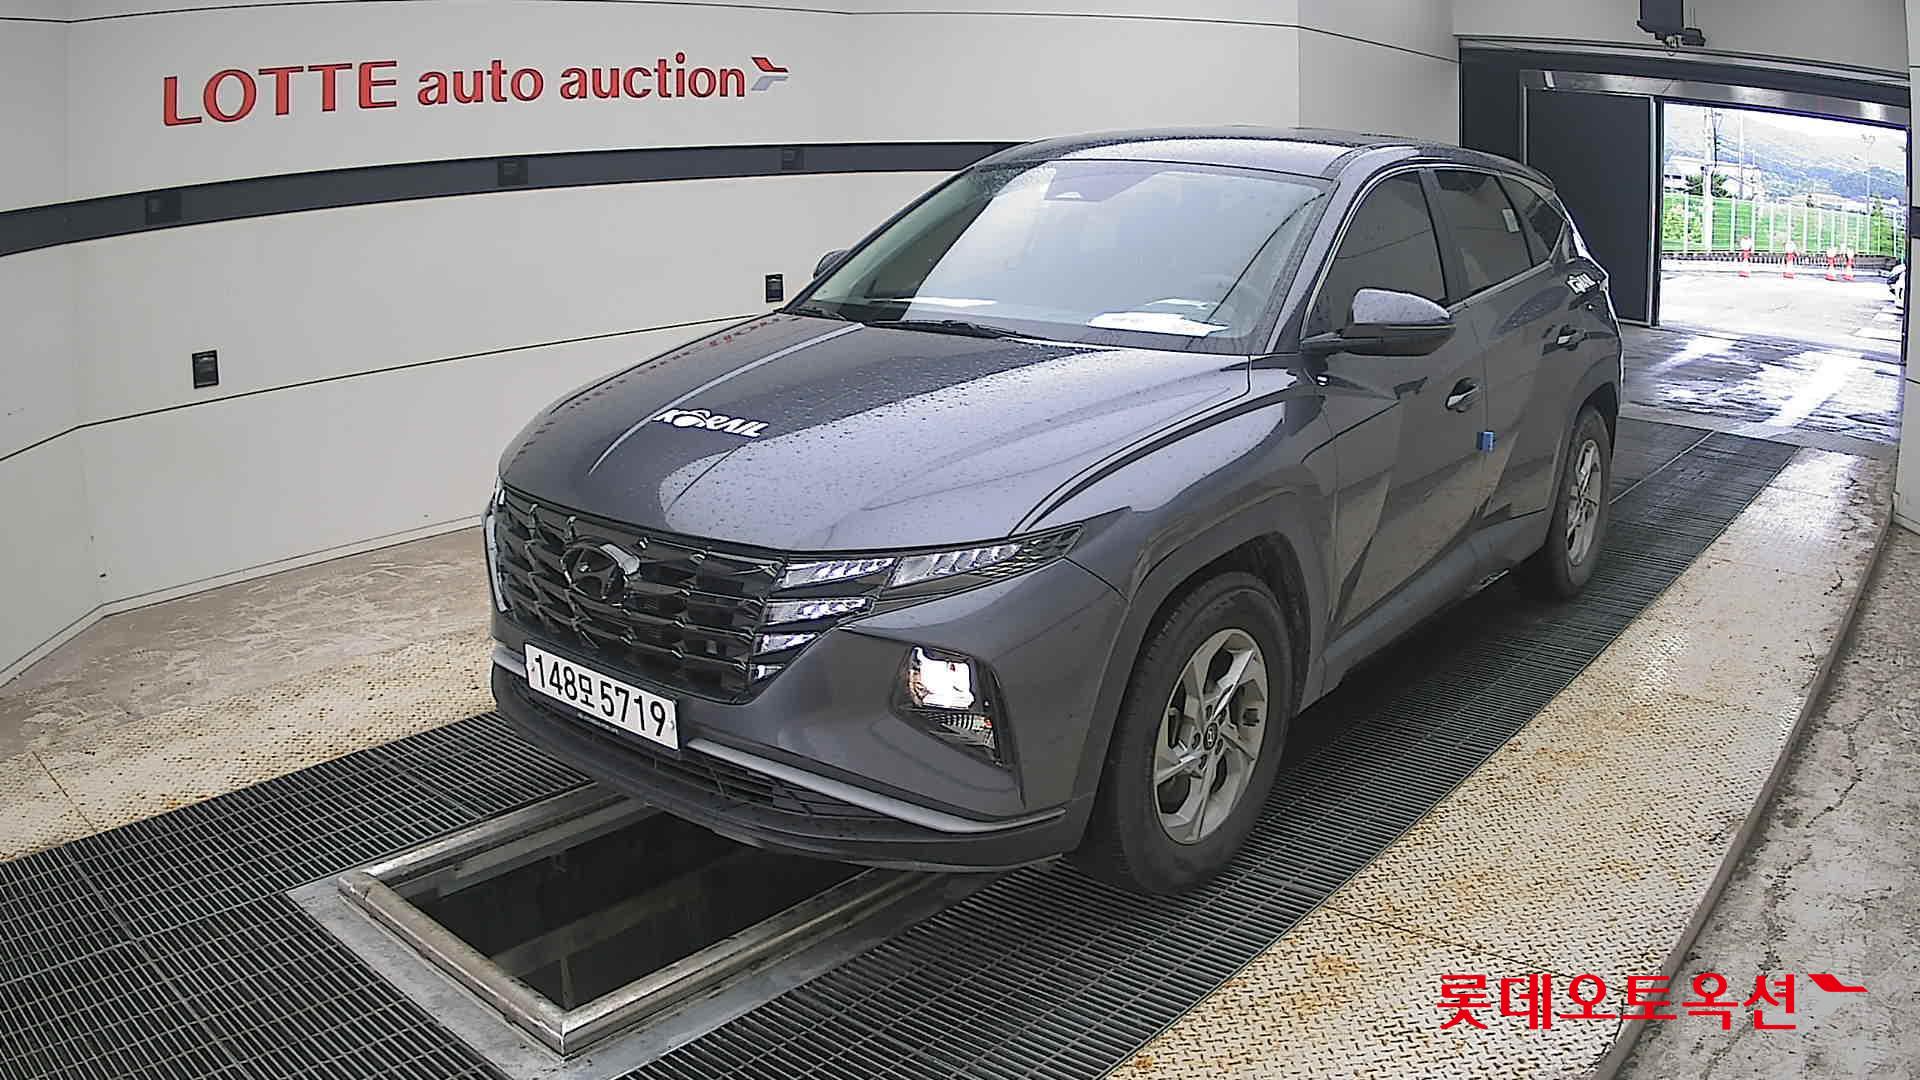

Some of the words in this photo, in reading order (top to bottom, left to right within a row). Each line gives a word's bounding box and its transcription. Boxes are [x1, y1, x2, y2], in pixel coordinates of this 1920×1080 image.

[164, 61, 397, 126] LOTTE
[417, 60, 544, 105] auto
[560, 53, 746, 99] auction
